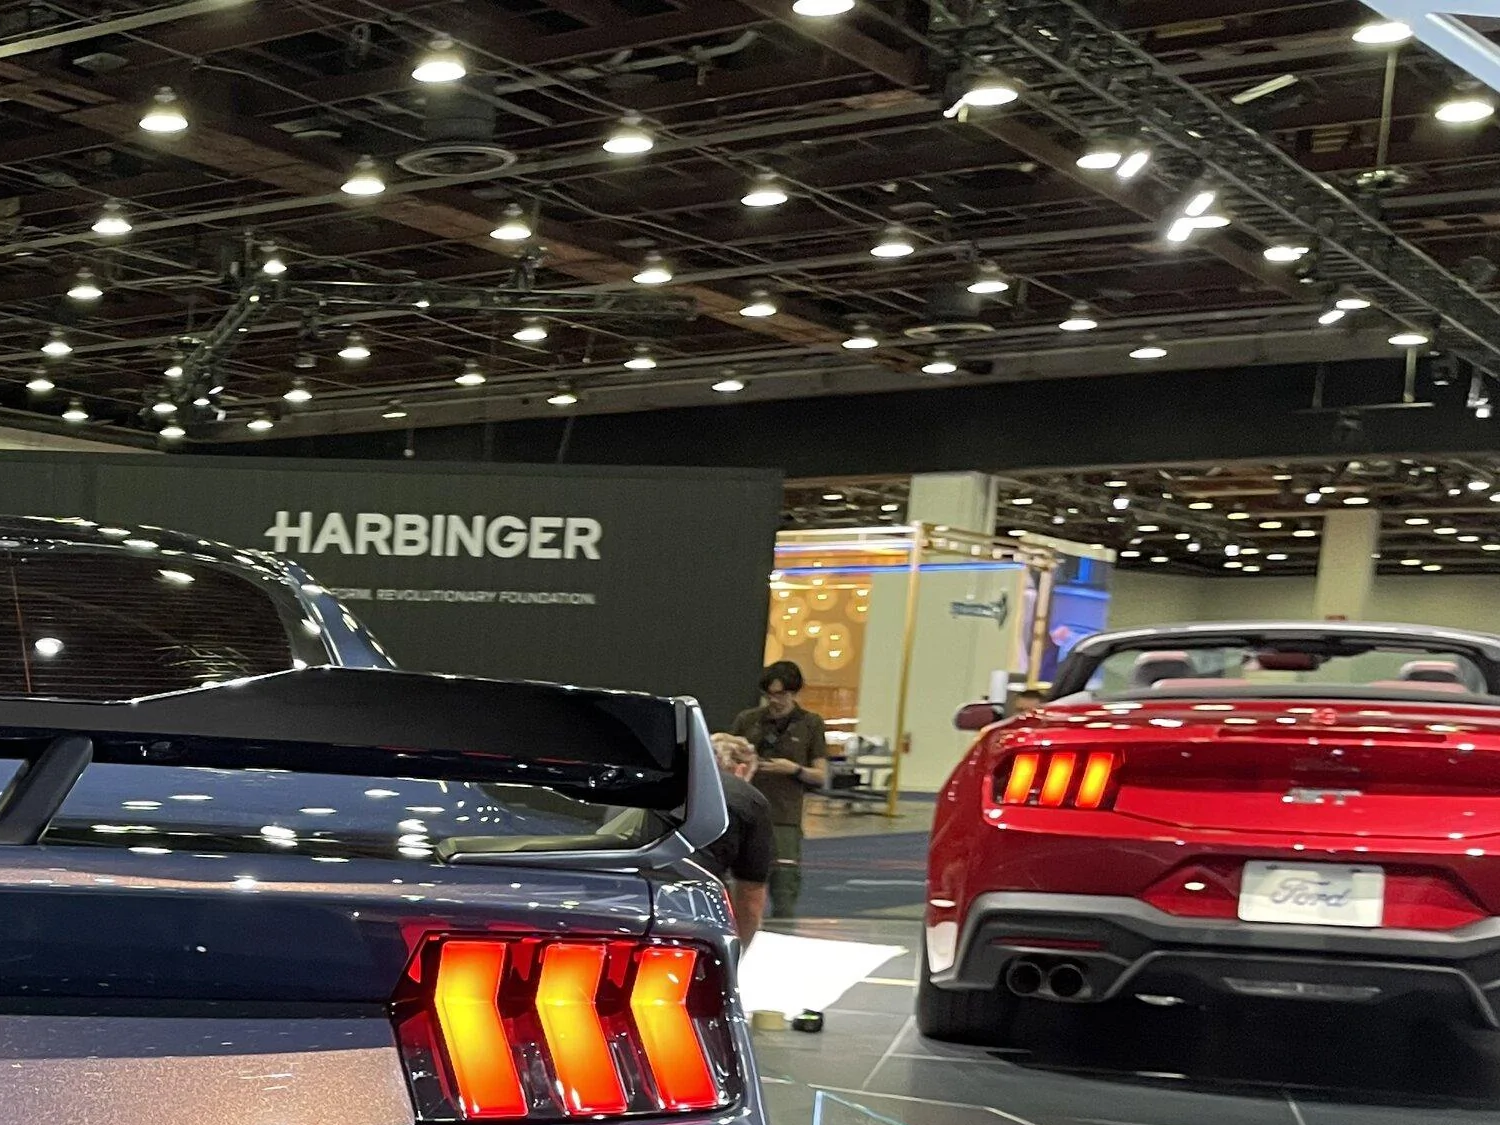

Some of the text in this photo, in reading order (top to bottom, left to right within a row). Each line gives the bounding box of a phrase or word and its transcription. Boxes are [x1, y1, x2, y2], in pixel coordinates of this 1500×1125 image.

[264, 510, 602, 560] HARBINGER
[376, 588, 498, 603] REVOLUTIONARY
[1270, 876, 1353, 908] Ford
